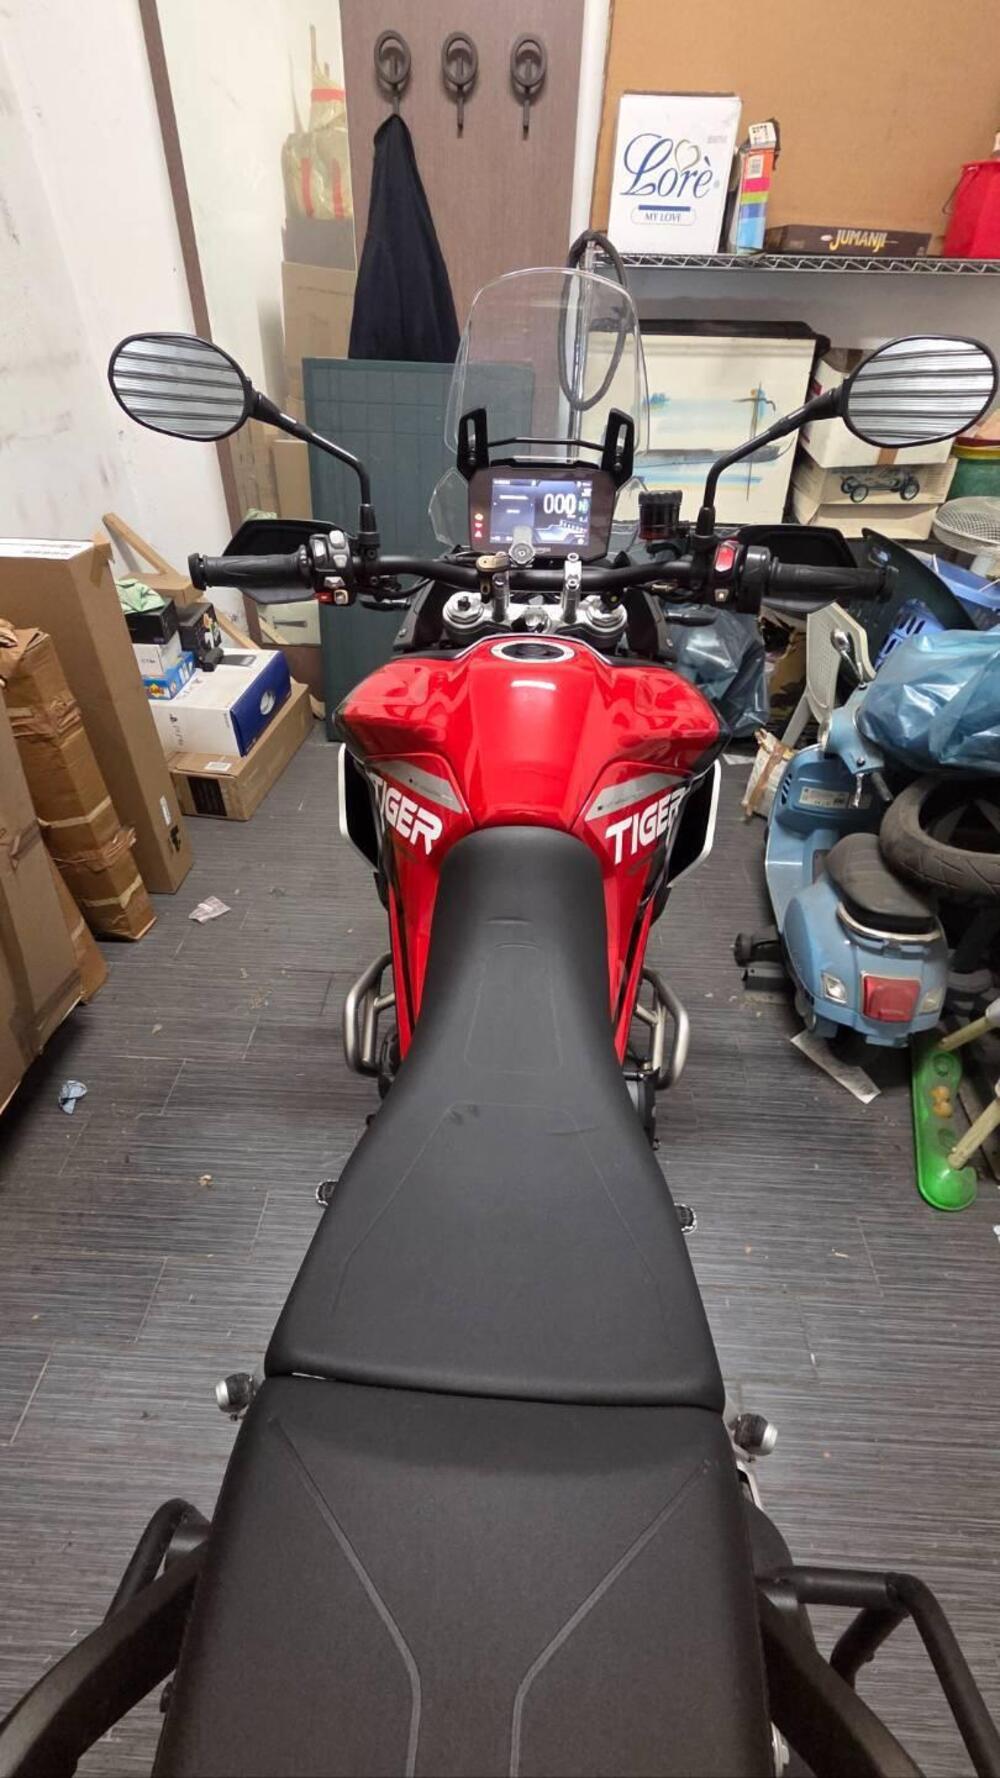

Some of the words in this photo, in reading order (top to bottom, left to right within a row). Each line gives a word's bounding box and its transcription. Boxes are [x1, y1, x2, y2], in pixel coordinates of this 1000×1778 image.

[620, 132, 713, 198] Lorè
[645, 212, 658, 222] MY
[660, 213, 682, 223] LOVE
[829, 229, 888, 253] JUMANJI
[543, 493, 576, 515] 000
[605, 787, 688, 865] TIGER
